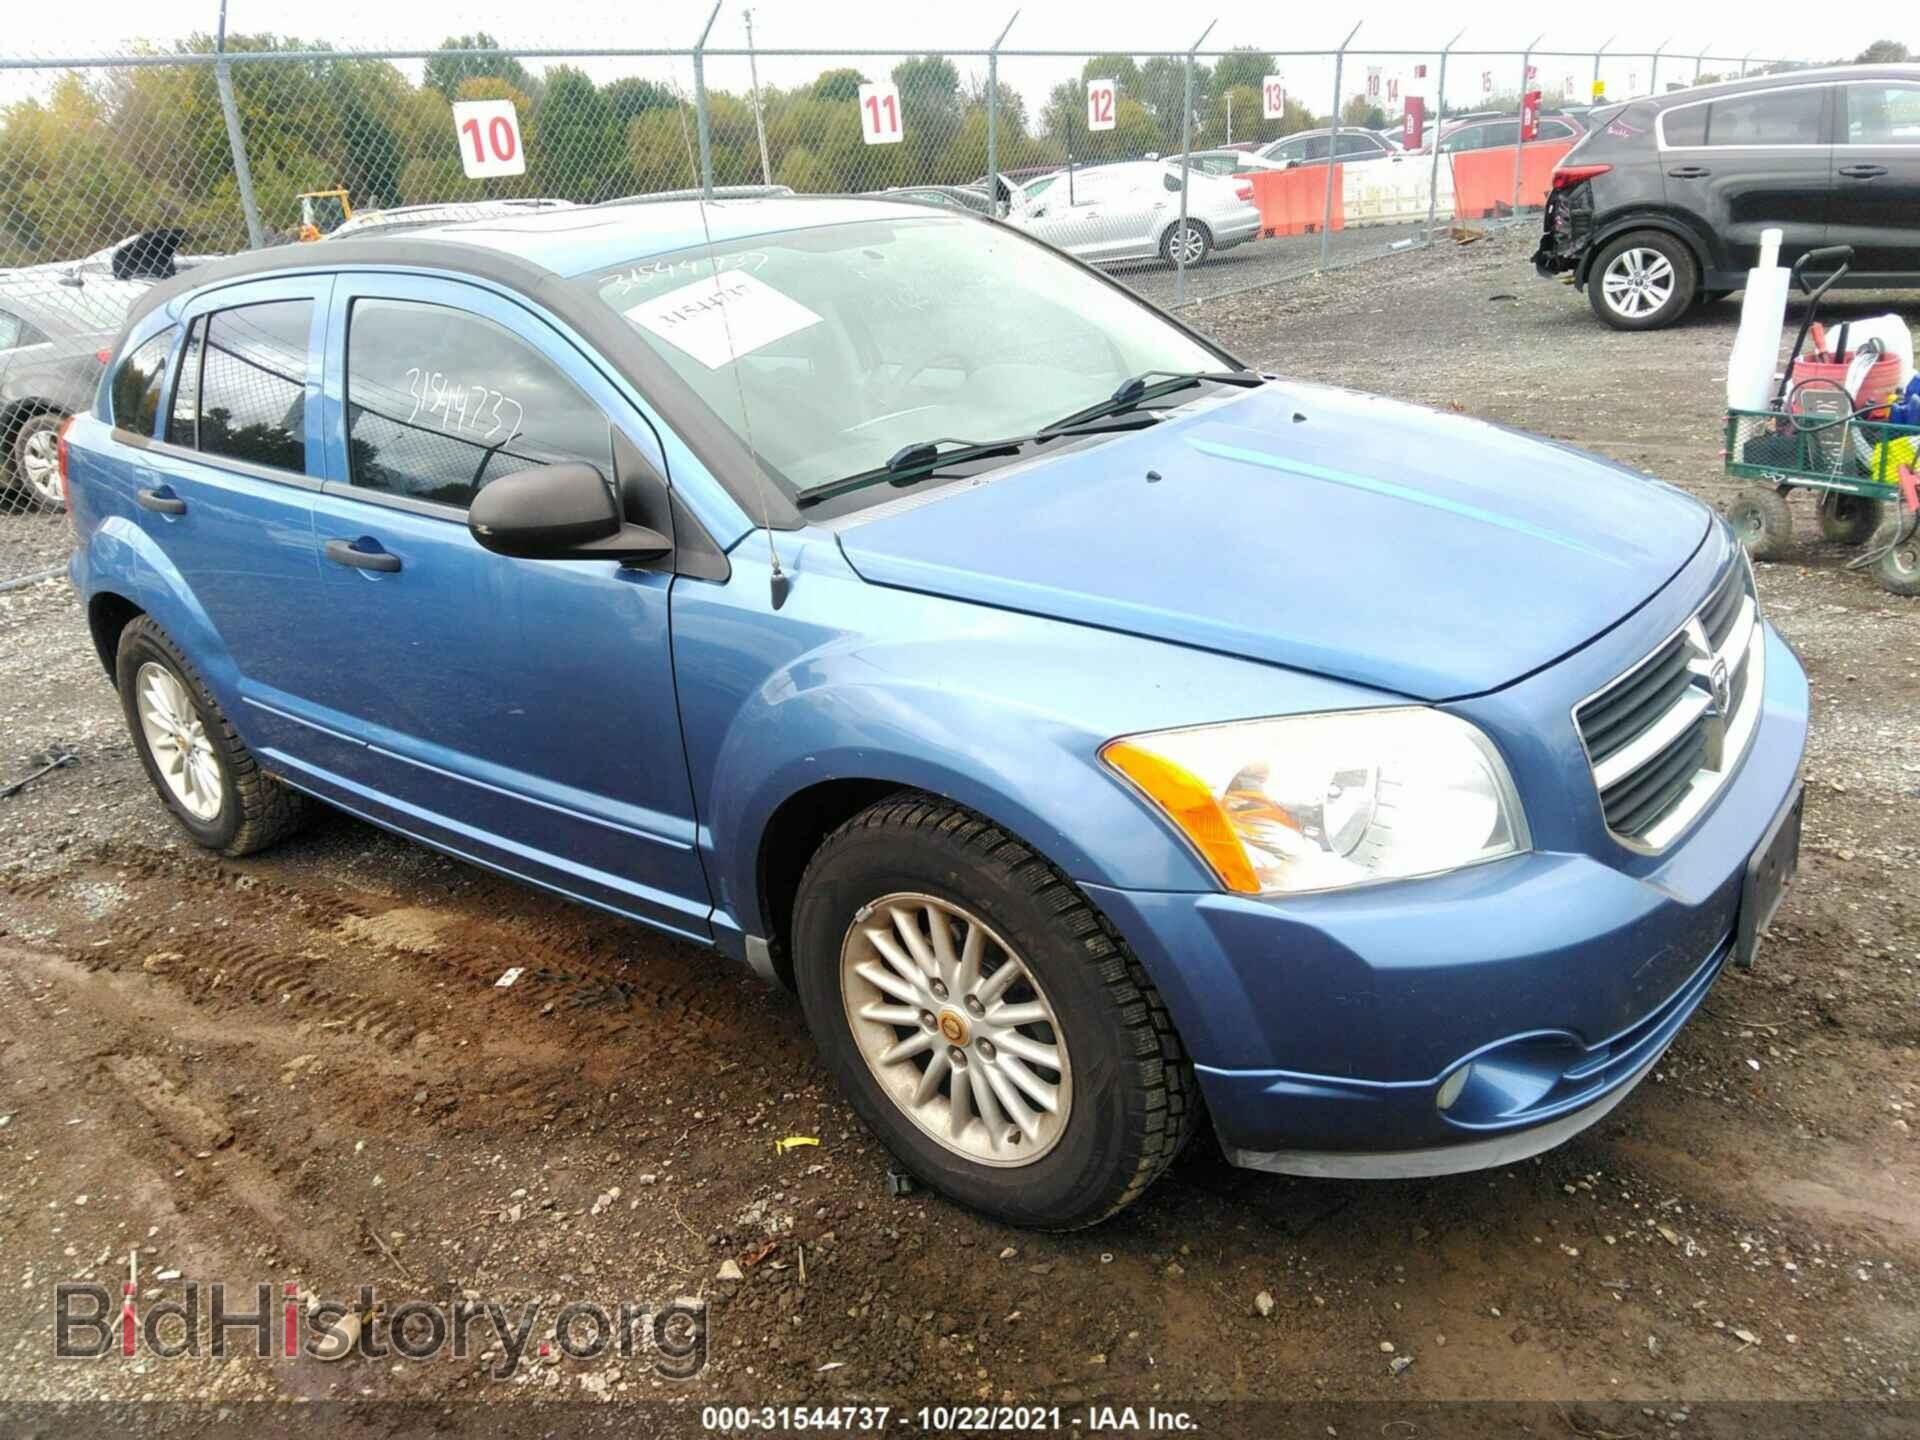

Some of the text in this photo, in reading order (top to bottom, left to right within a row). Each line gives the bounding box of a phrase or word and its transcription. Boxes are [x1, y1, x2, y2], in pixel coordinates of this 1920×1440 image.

[1367, 75, 1380, 96] 10
[1387, 79, 1398, 102] 14
[1482, 71, 1492, 92] 15
[1090, 88, 1113, 123] 12
[1266, 83, 1282, 112] 13
[865, 95, 899, 134] 11
[462, 115, 517, 164] 10
